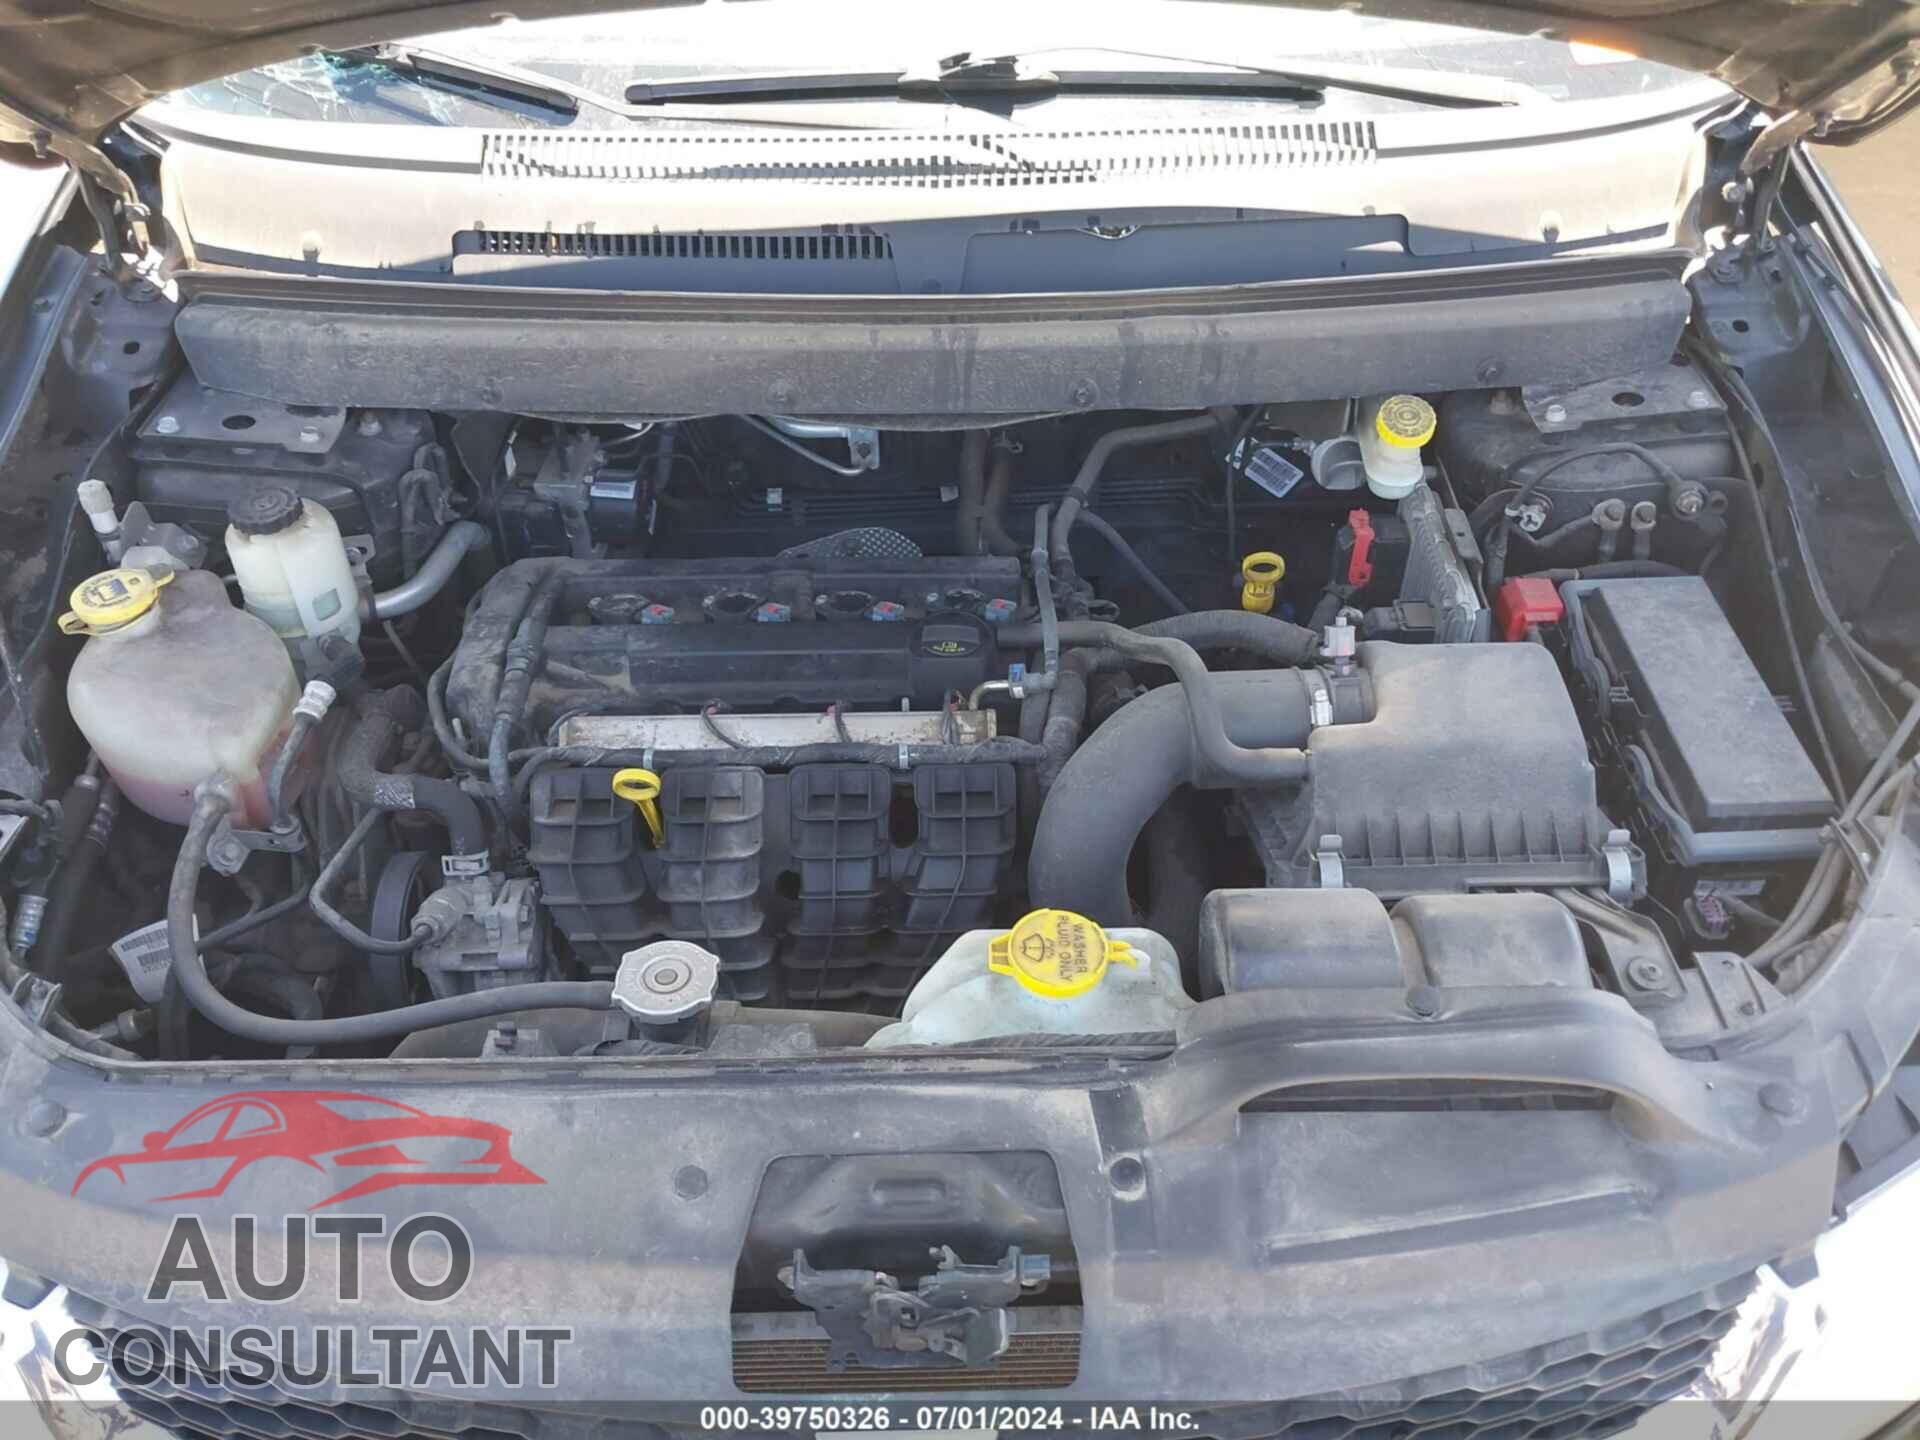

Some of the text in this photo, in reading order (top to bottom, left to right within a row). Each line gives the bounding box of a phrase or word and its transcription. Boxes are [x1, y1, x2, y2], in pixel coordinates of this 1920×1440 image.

[1056, 915, 1073, 982] FLUID ONLY
[1073, 923, 1088, 974] WASHER
